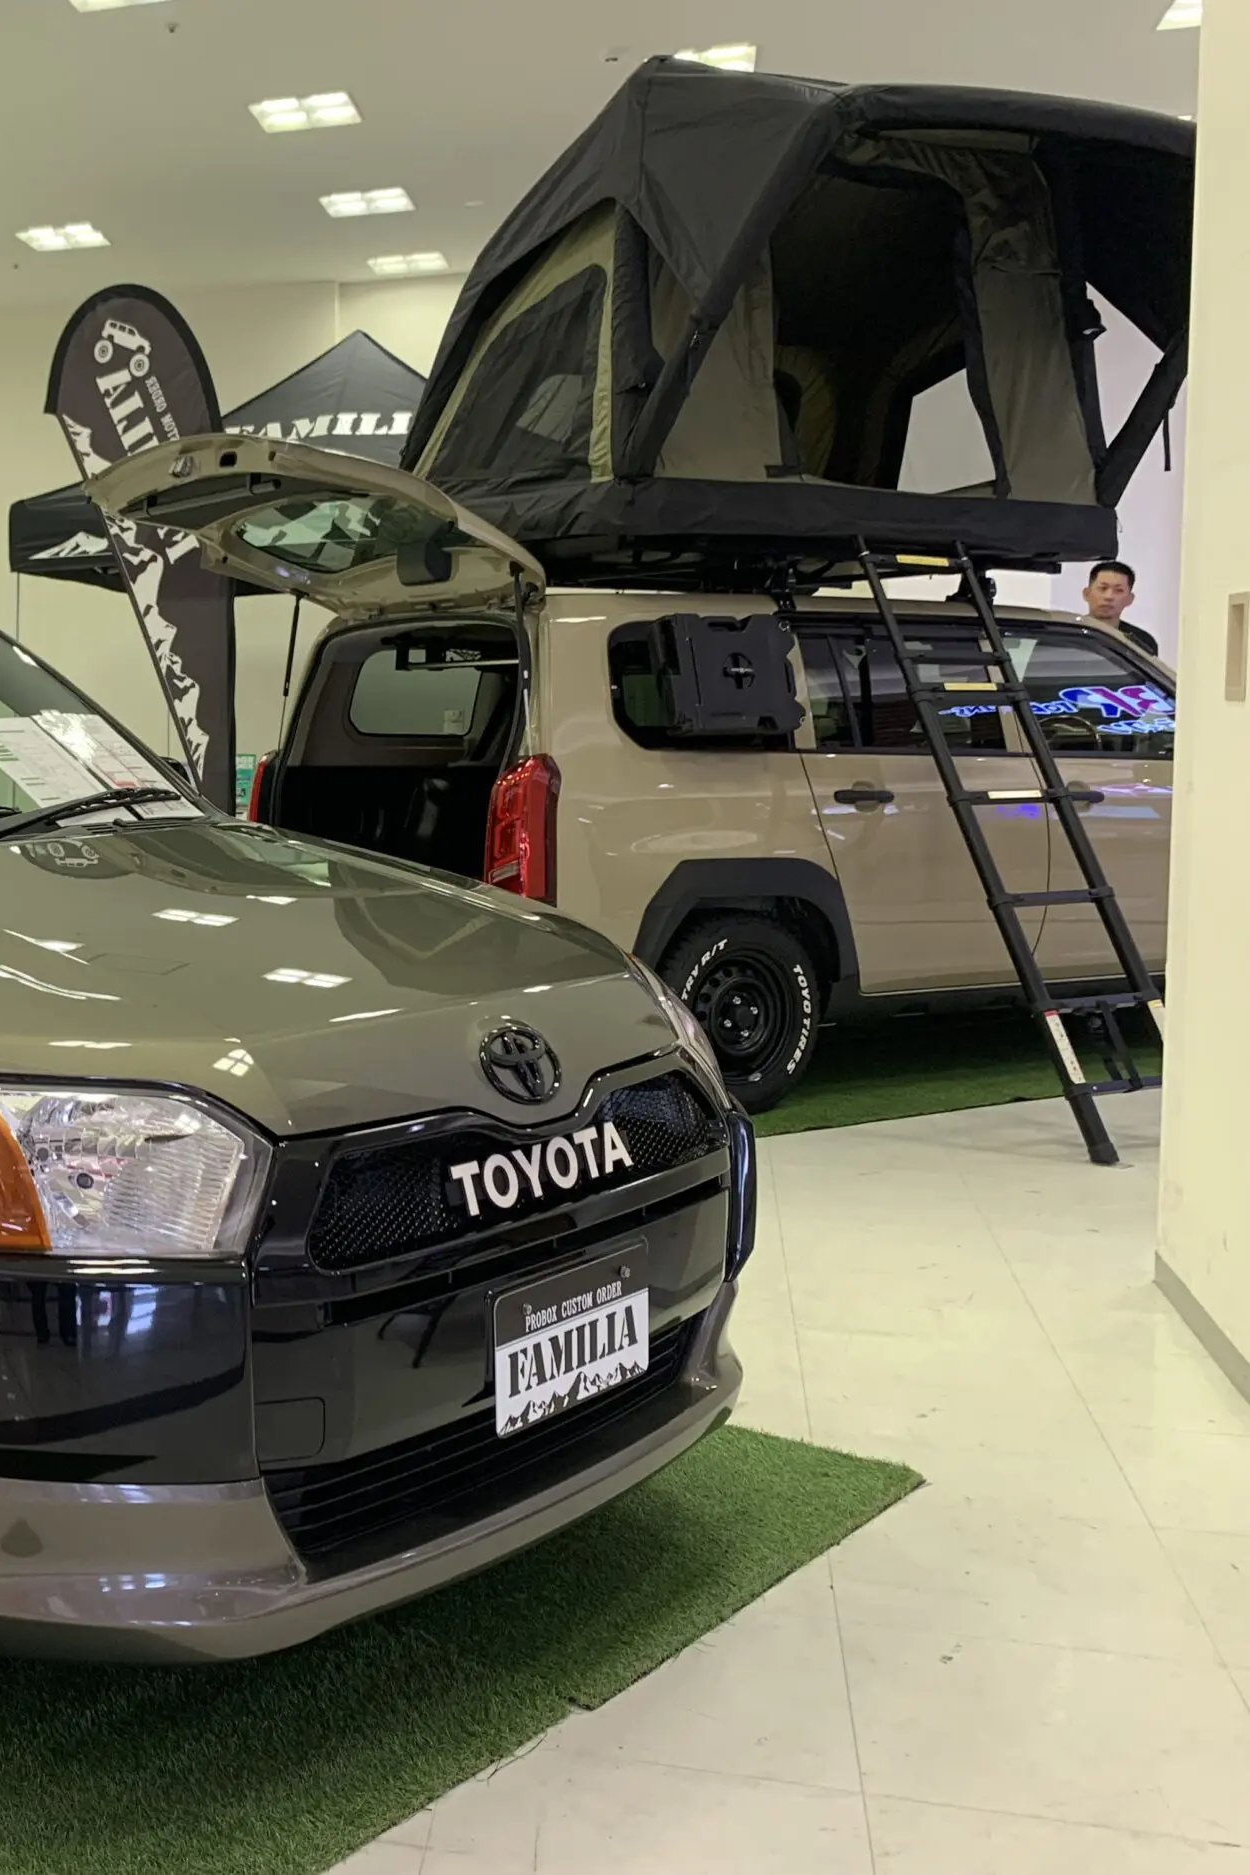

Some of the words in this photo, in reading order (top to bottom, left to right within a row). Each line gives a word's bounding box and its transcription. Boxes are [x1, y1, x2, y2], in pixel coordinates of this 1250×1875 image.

[224, 411, 413, 443] FAMILI
[793, 964, 812, 1014] TOYO
[786, 1017, 812, 1075] TIRES
[450, 1121, 635, 1217] TOYOTA
[525, 1305, 558, 1333] PROBOX
[561, 1290, 593, 1322] CUSTOM
[596, 1281, 623, 1307] ORDER
[508, 1304, 639, 1399] FAMILIA
